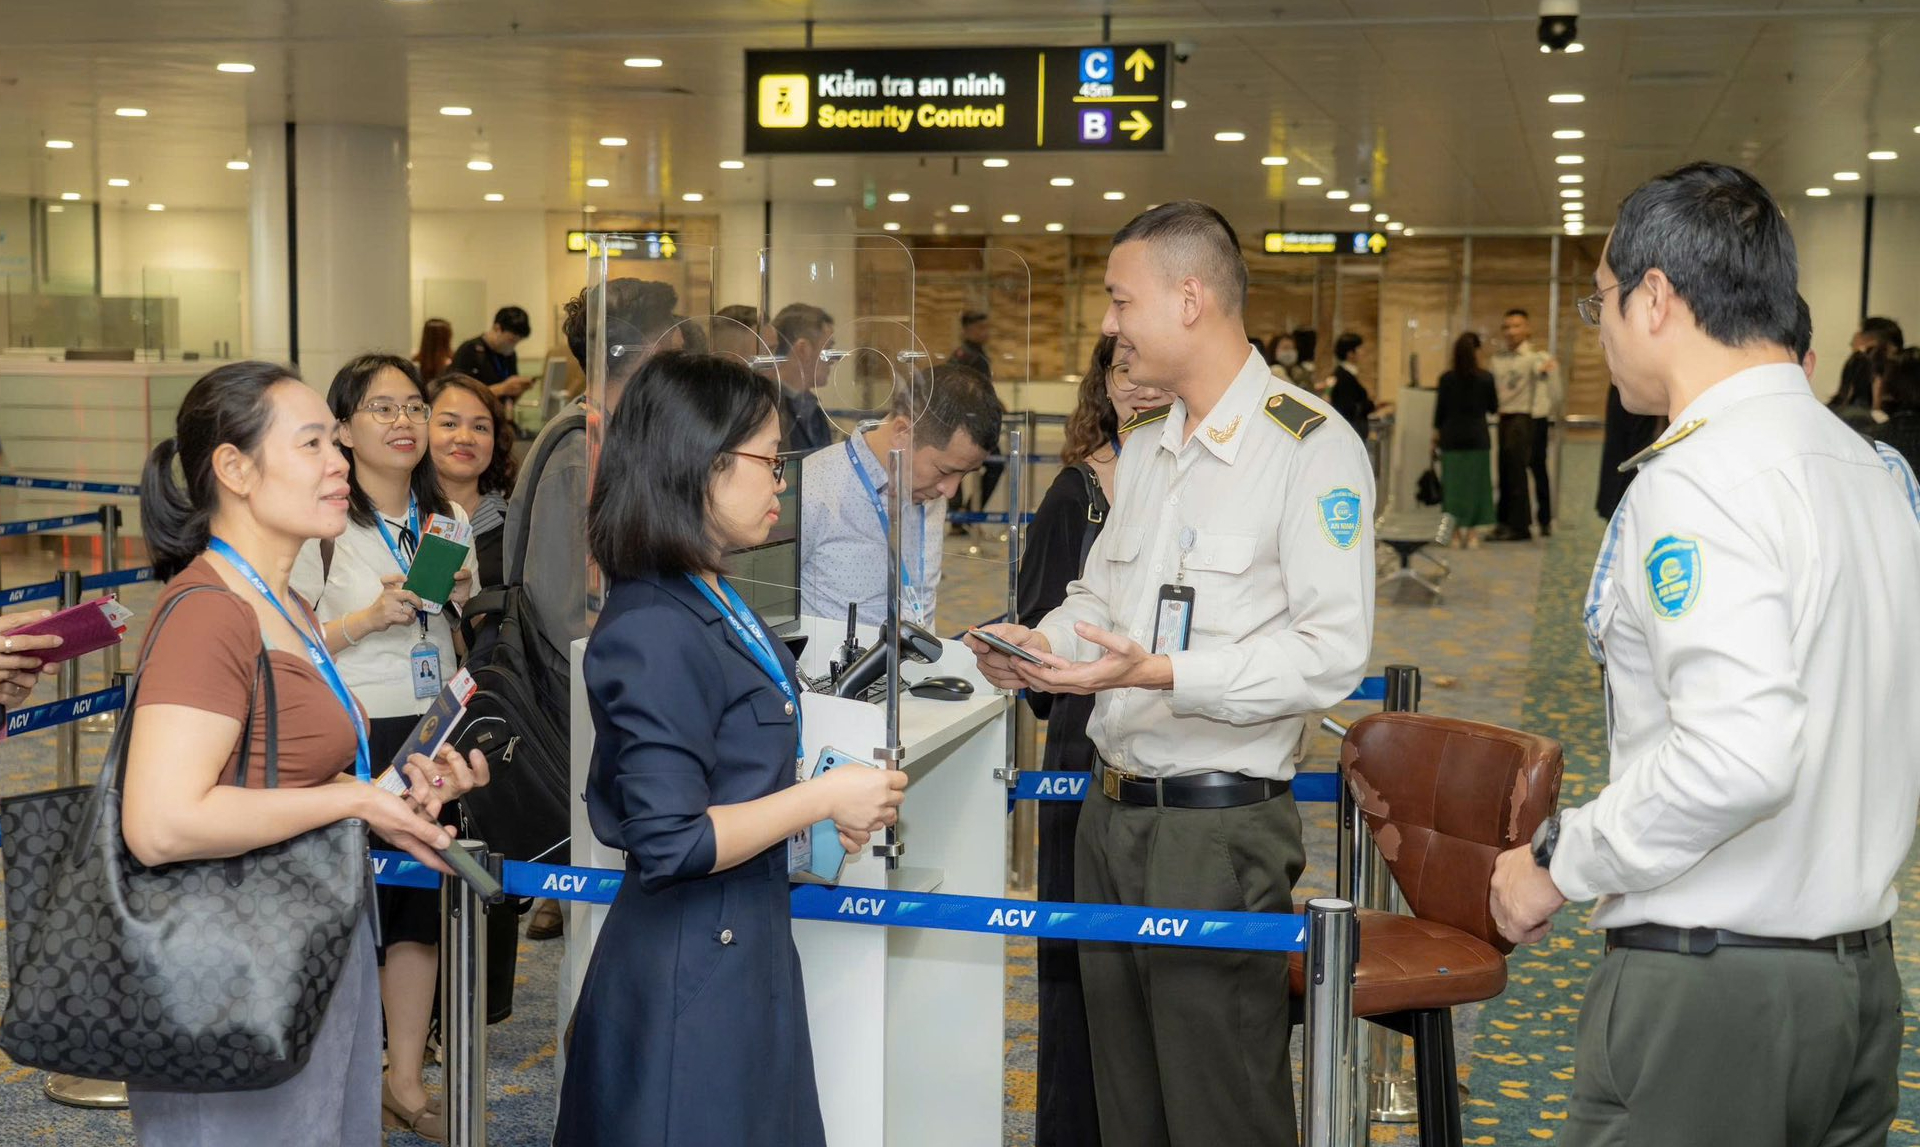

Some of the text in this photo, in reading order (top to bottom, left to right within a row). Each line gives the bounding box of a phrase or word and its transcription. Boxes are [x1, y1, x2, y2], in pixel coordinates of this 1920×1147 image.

[1084, 51, 1109, 80] C
[881, 76, 911, 98] tra
[918, 79, 950, 98] an
[953, 72, 1006, 97] ninh
[1079, 82, 1114, 98] 45m
[818, 103, 1005, 133] Security Control
[1083, 111, 1107, 140] B
[9, 589, 25, 603] ACV
[780, 681, 793, 696] ACV
[8, 698, 93, 730] ACV ACV
[1035, 776, 1085, 796] ACV
[542, 872, 1189, 938] ACV ACV ACV ACV
